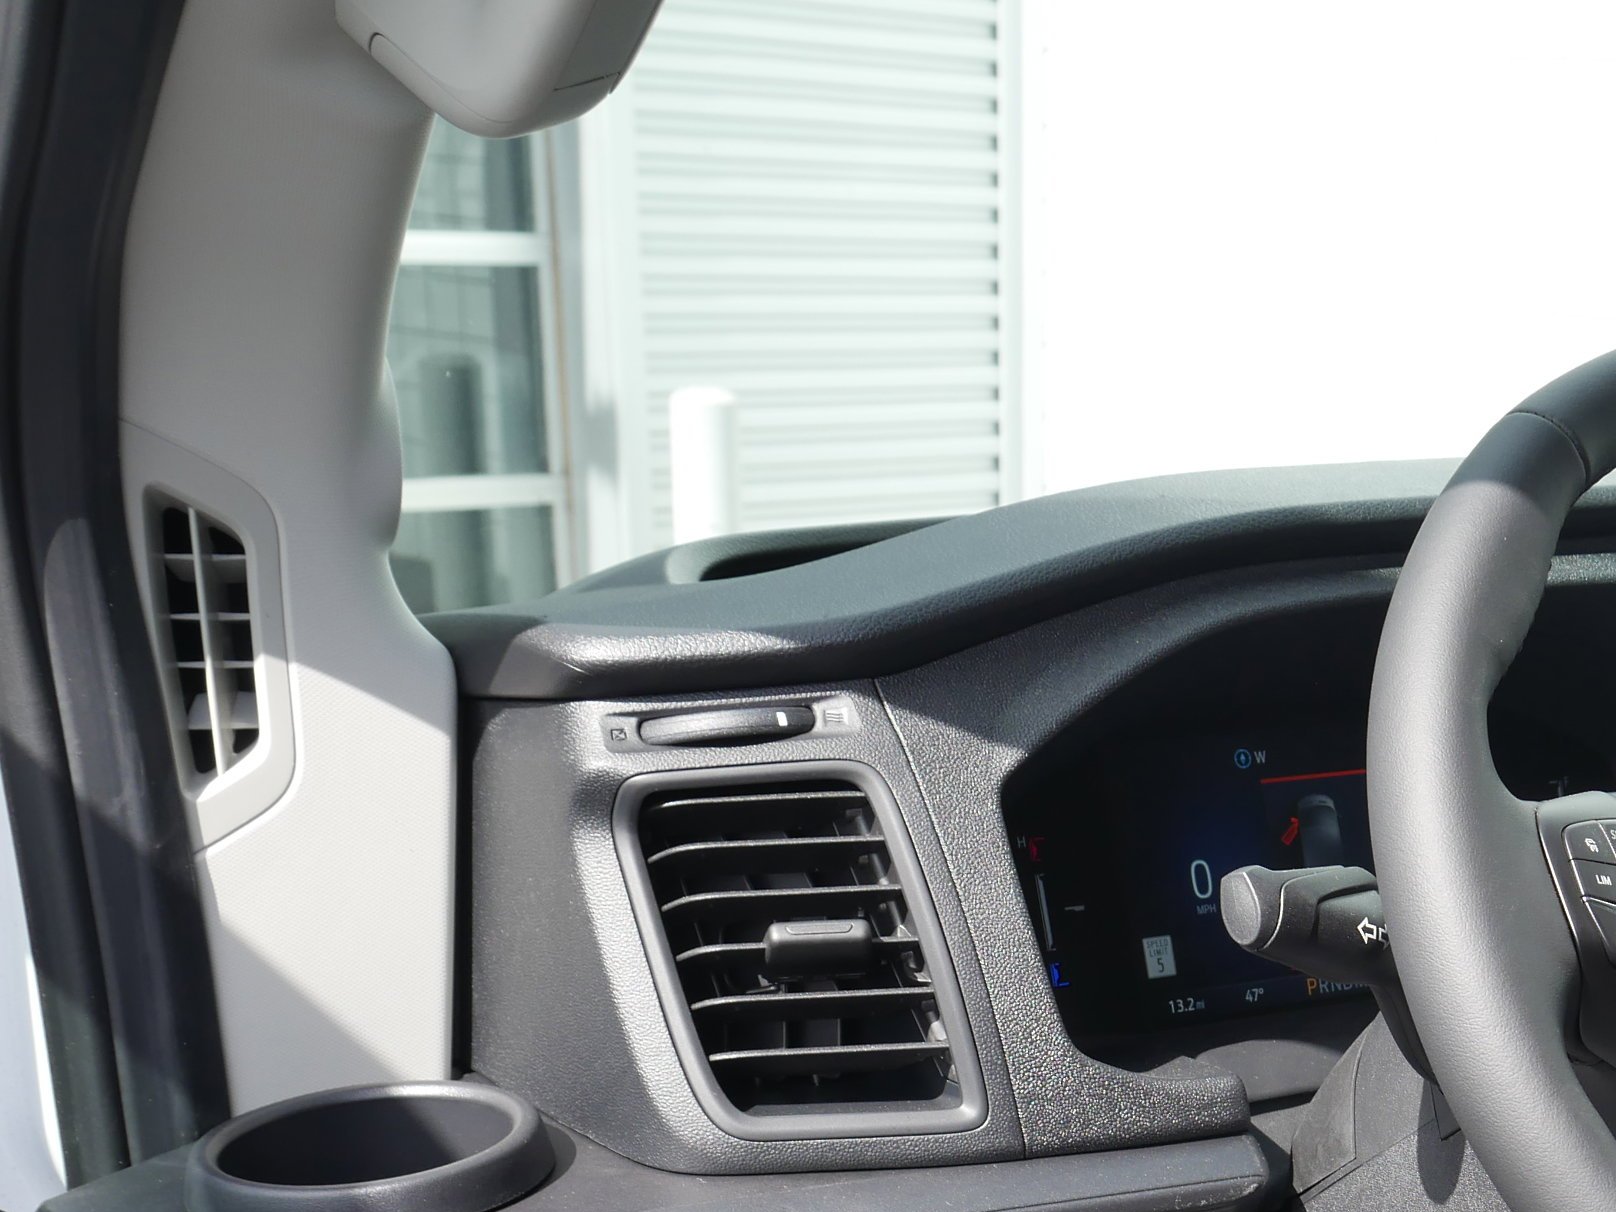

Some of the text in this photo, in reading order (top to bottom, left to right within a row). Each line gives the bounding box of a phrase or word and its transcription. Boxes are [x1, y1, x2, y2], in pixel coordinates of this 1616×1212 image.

[1254, 751, 1266, 764] W
[1016, 836, 1026, 848] H
[1190, 860, 1213, 899] 0
[1595, 874, 1612, 886] LIM
[1196, 903, 1217, 915] MPH
[1146, 938, 1169, 949] SPEED
[1149, 947, 1168, 958] LIMIT
[1157, 957, 1165, 973] 5
[1245, 987, 1265, 1003] 47°
